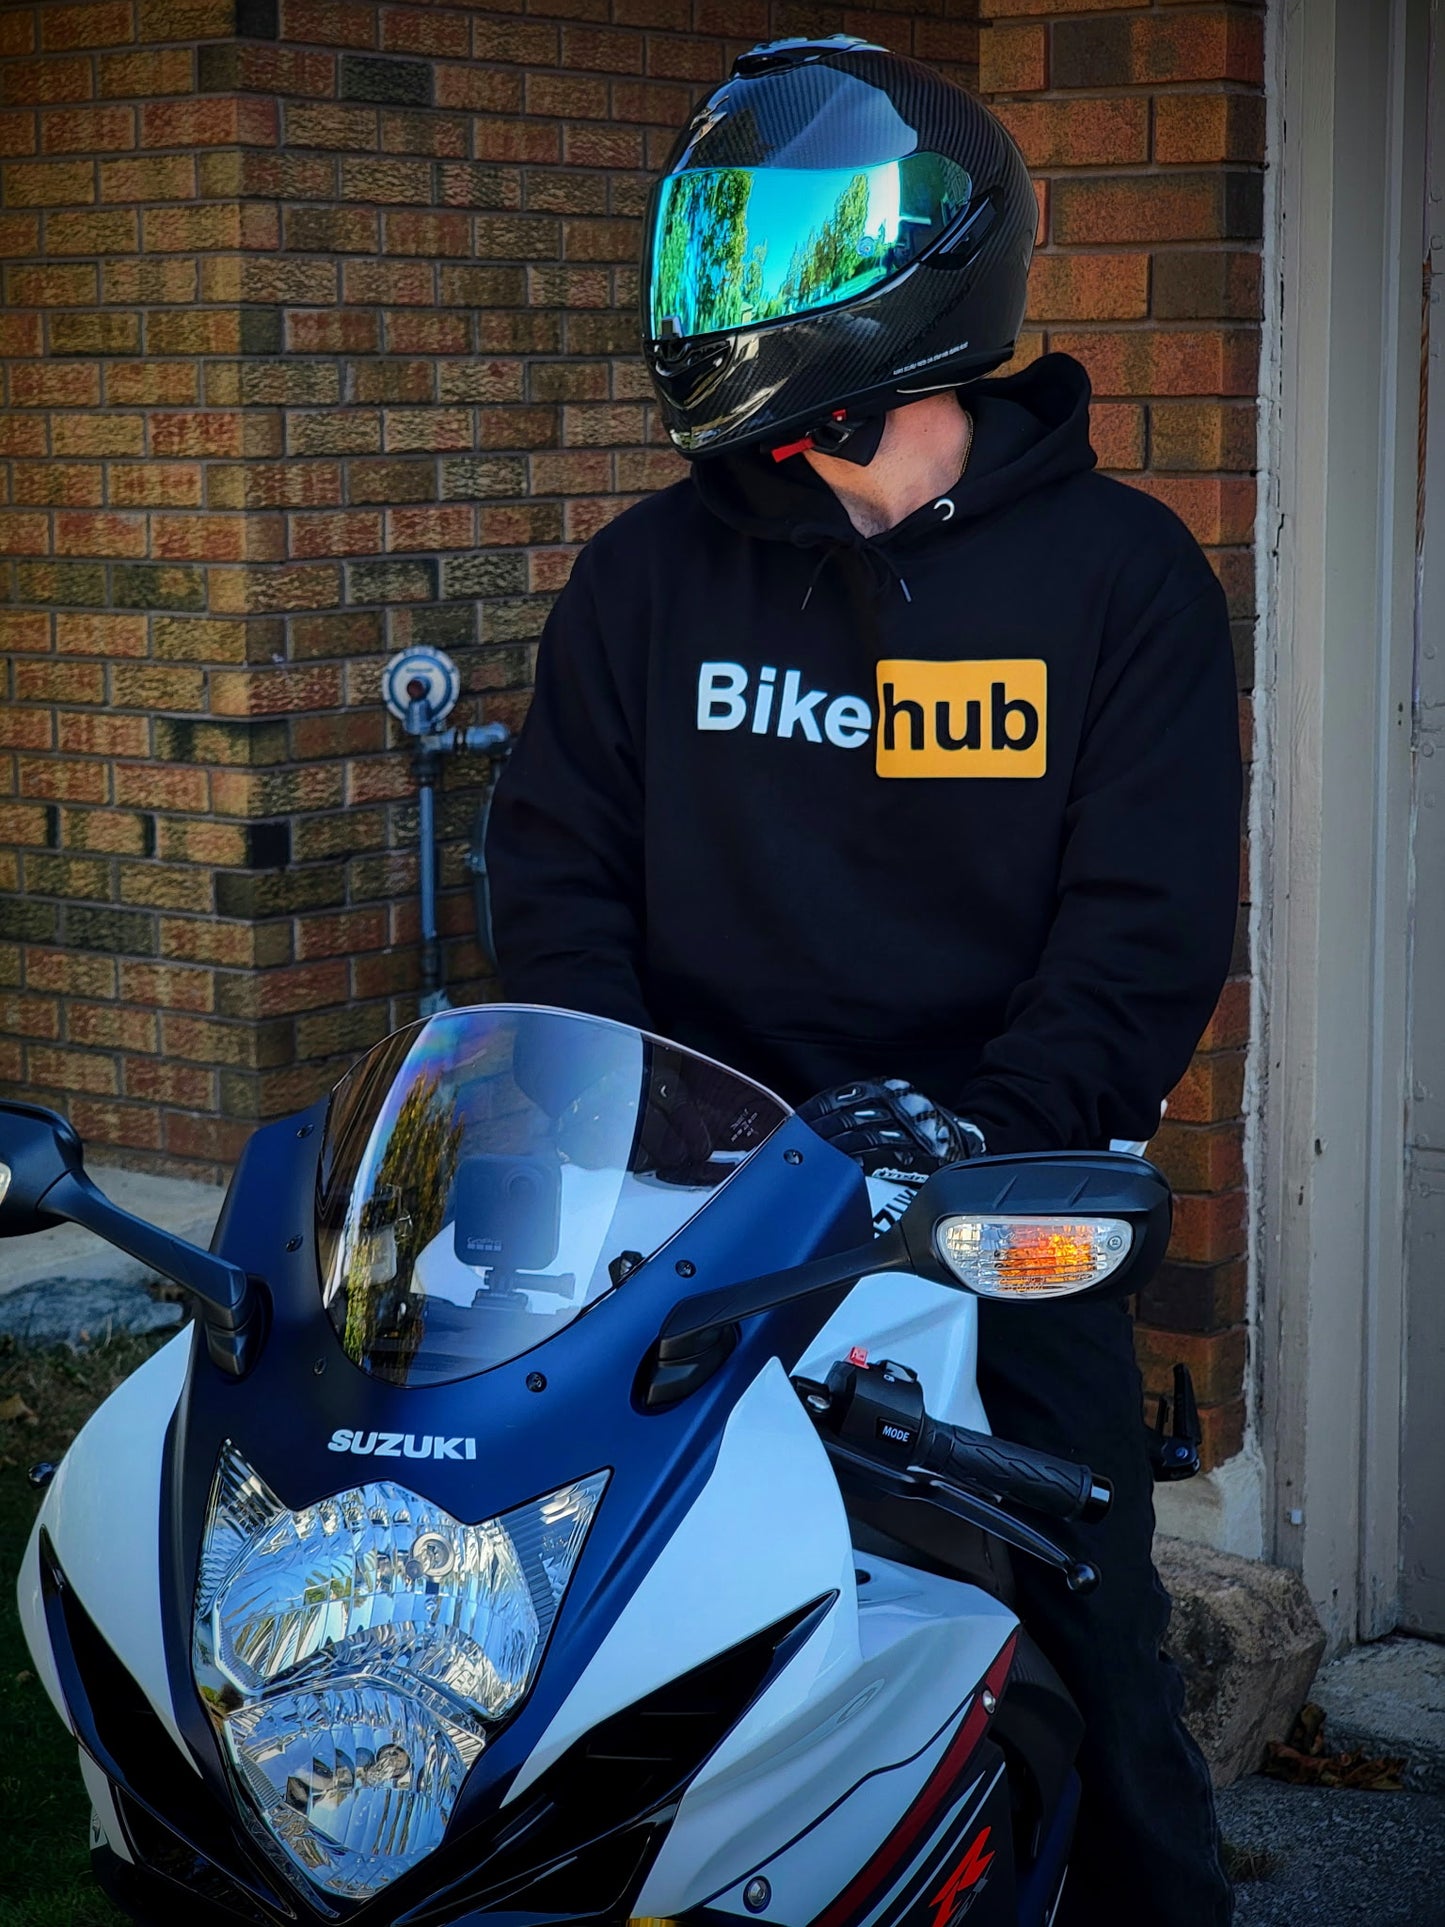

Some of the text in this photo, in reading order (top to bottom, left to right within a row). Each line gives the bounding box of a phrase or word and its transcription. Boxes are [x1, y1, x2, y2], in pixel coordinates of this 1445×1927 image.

[697, 661, 1039, 751] Bike hub
[328, 1429, 476, 1460] SUZUKI
[882, 1425, 910, 1442] MODE
